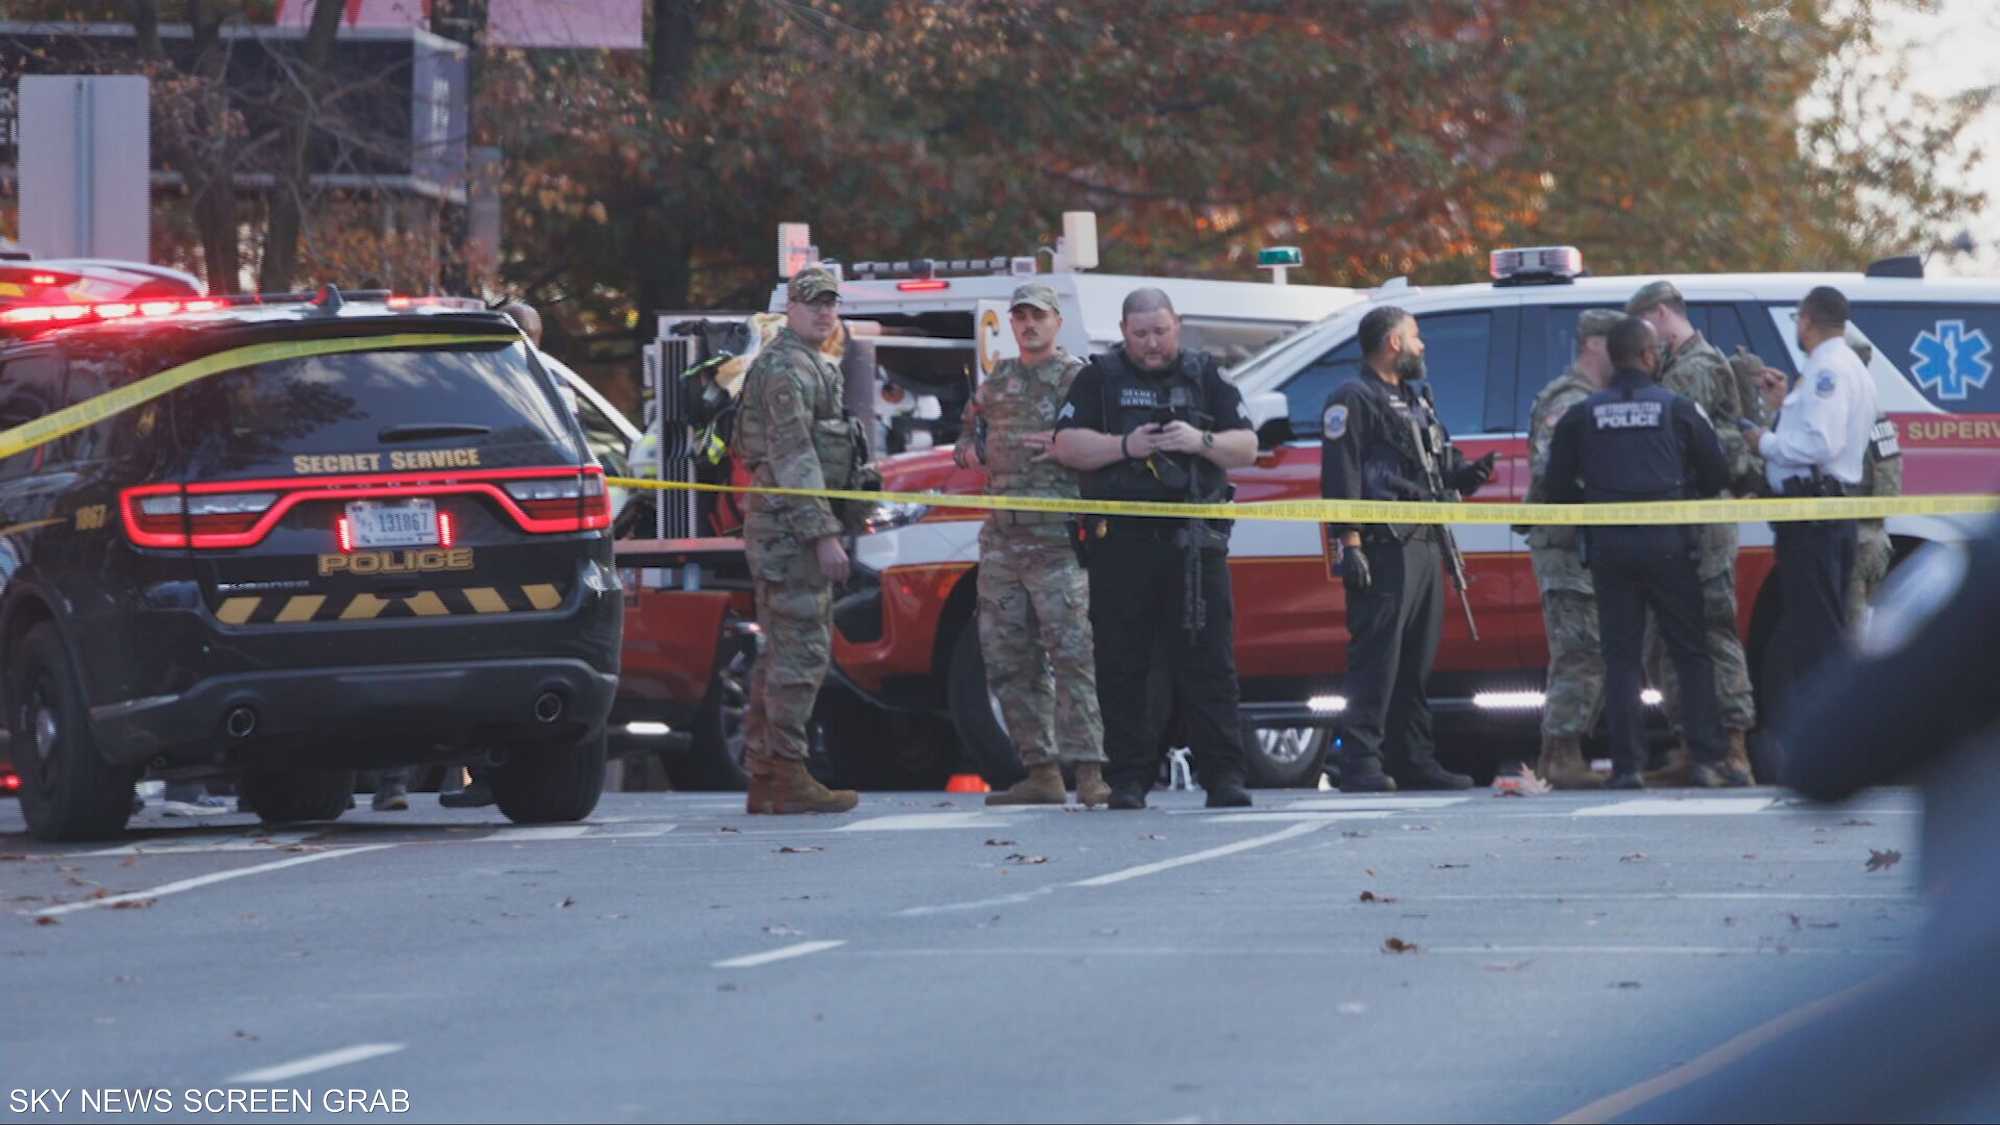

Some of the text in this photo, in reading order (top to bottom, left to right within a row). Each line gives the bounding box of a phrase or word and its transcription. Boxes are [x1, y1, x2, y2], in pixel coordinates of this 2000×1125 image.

[1597, 413, 1660, 429] POLICE
[293, 448, 481, 474] SECRET SERVICE
[318, 548, 474, 576] POLICE
